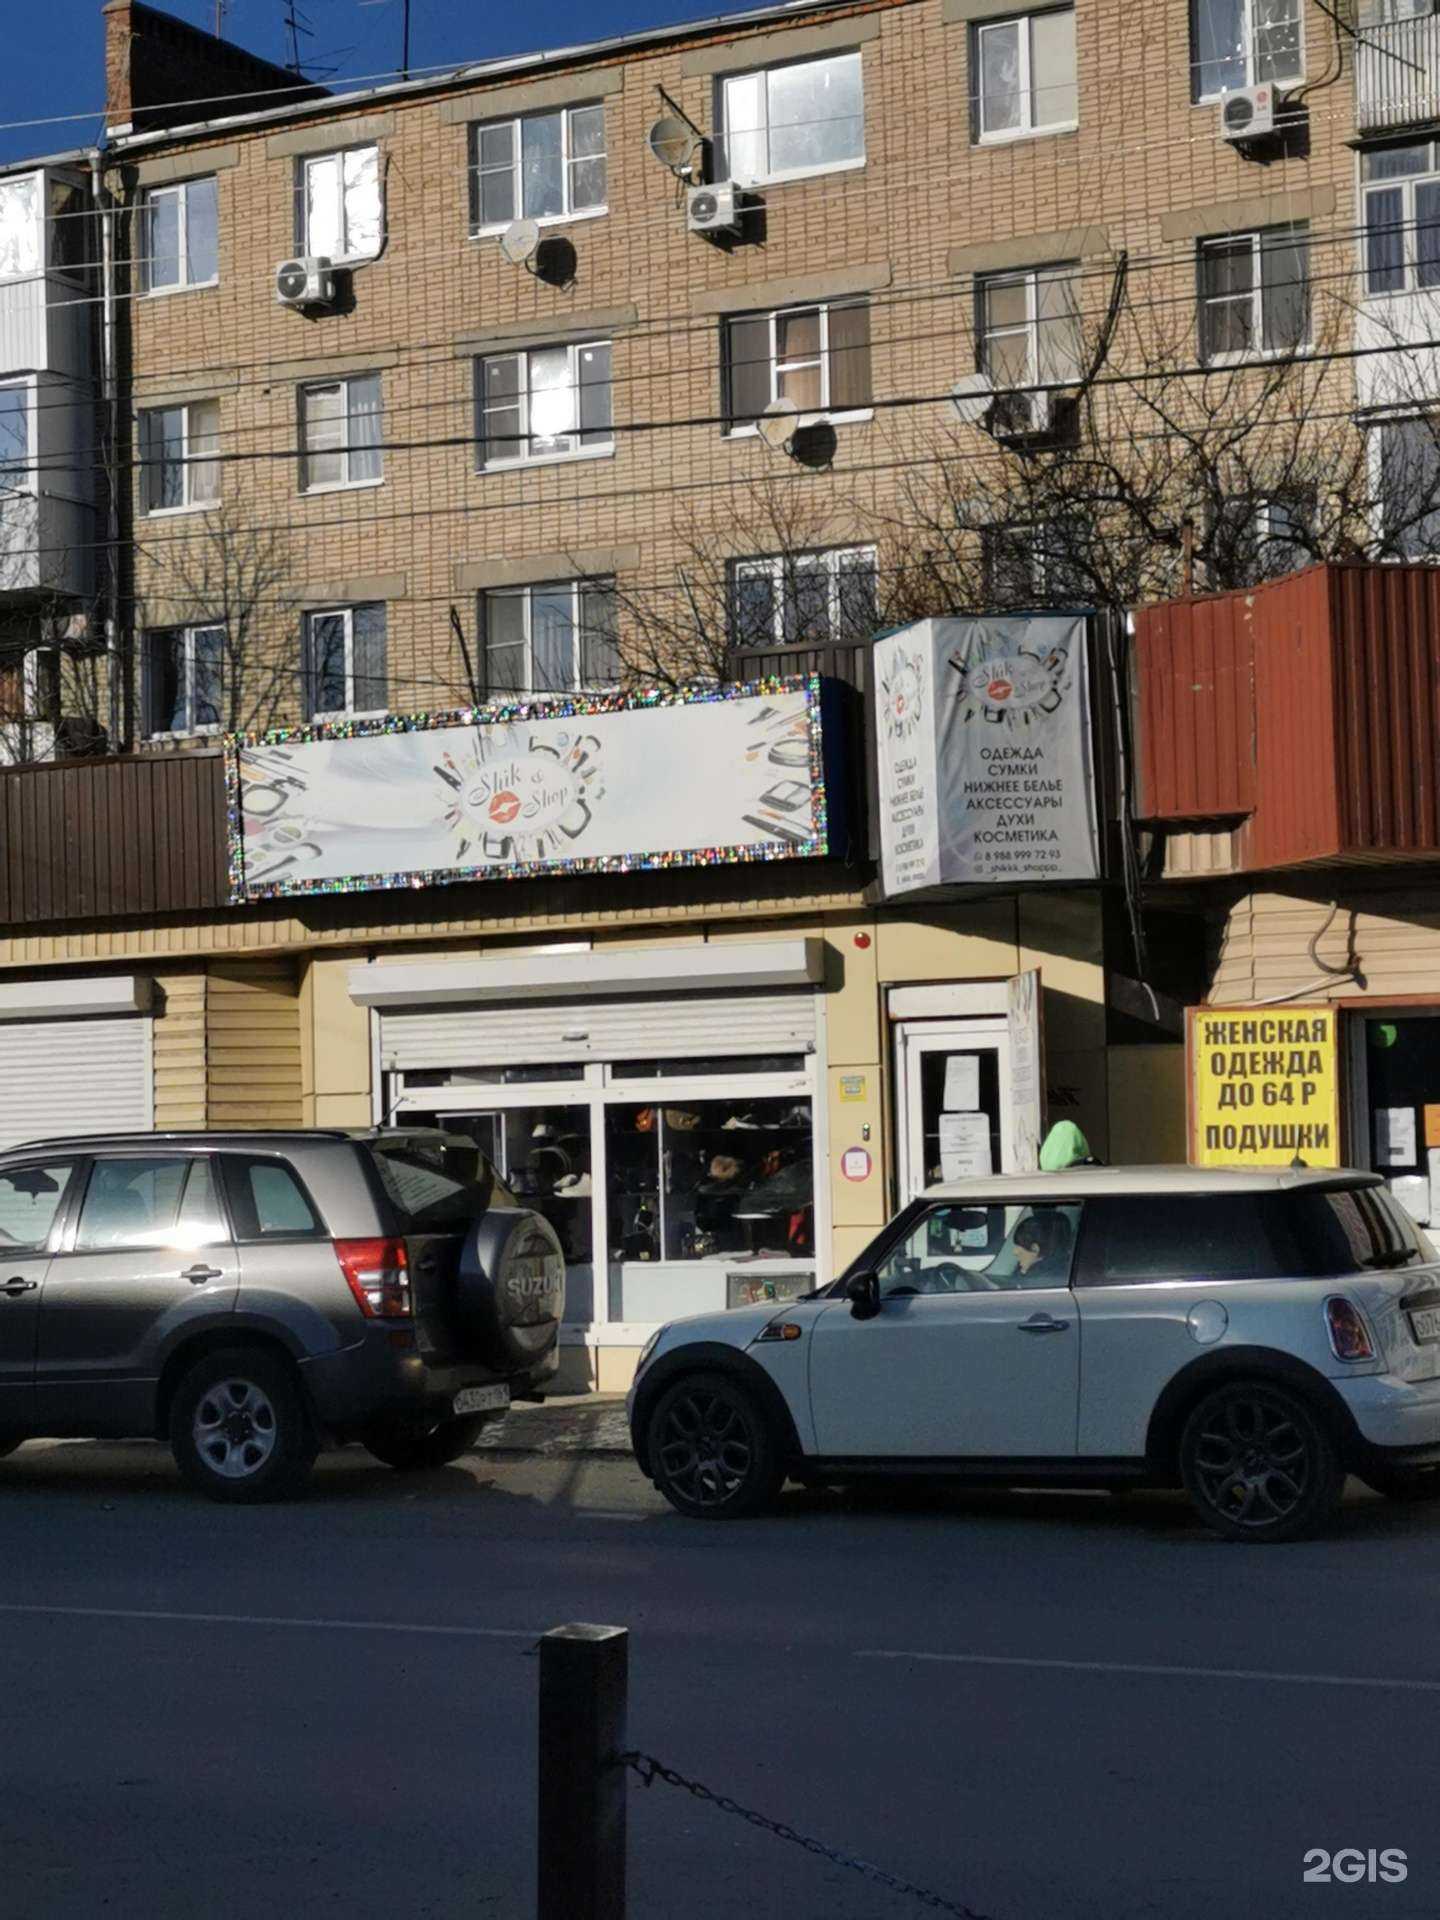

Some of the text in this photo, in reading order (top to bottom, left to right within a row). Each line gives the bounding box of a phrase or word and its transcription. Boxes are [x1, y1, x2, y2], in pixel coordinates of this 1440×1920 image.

[980, 747, 1044, 761] ОДЕЖДА
[987, 763, 1038, 776] СУМКИ
[468, 763, 521, 807] Shik
[963, 779, 1063, 793] НИЖНЕЕ БЕЛЬЕ
[522, 787, 568, 819] Shop
[966, 796, 1063, 810] АКСЕССУАРЫ
[996, 813, 1035, 828] ДУХИ
[974, 830, 1059, 843] КОСМЕТИКА
[1205, 1018, 1328, 1045] ЖЕНСКАЯ
[1211, 1050, 1323, 1079] ОДЕЖДА
[1218, 1081, 1316, 1110] ДО 64 Р
[1206, 1123, 1329, 1153] ПОДУШКИ
